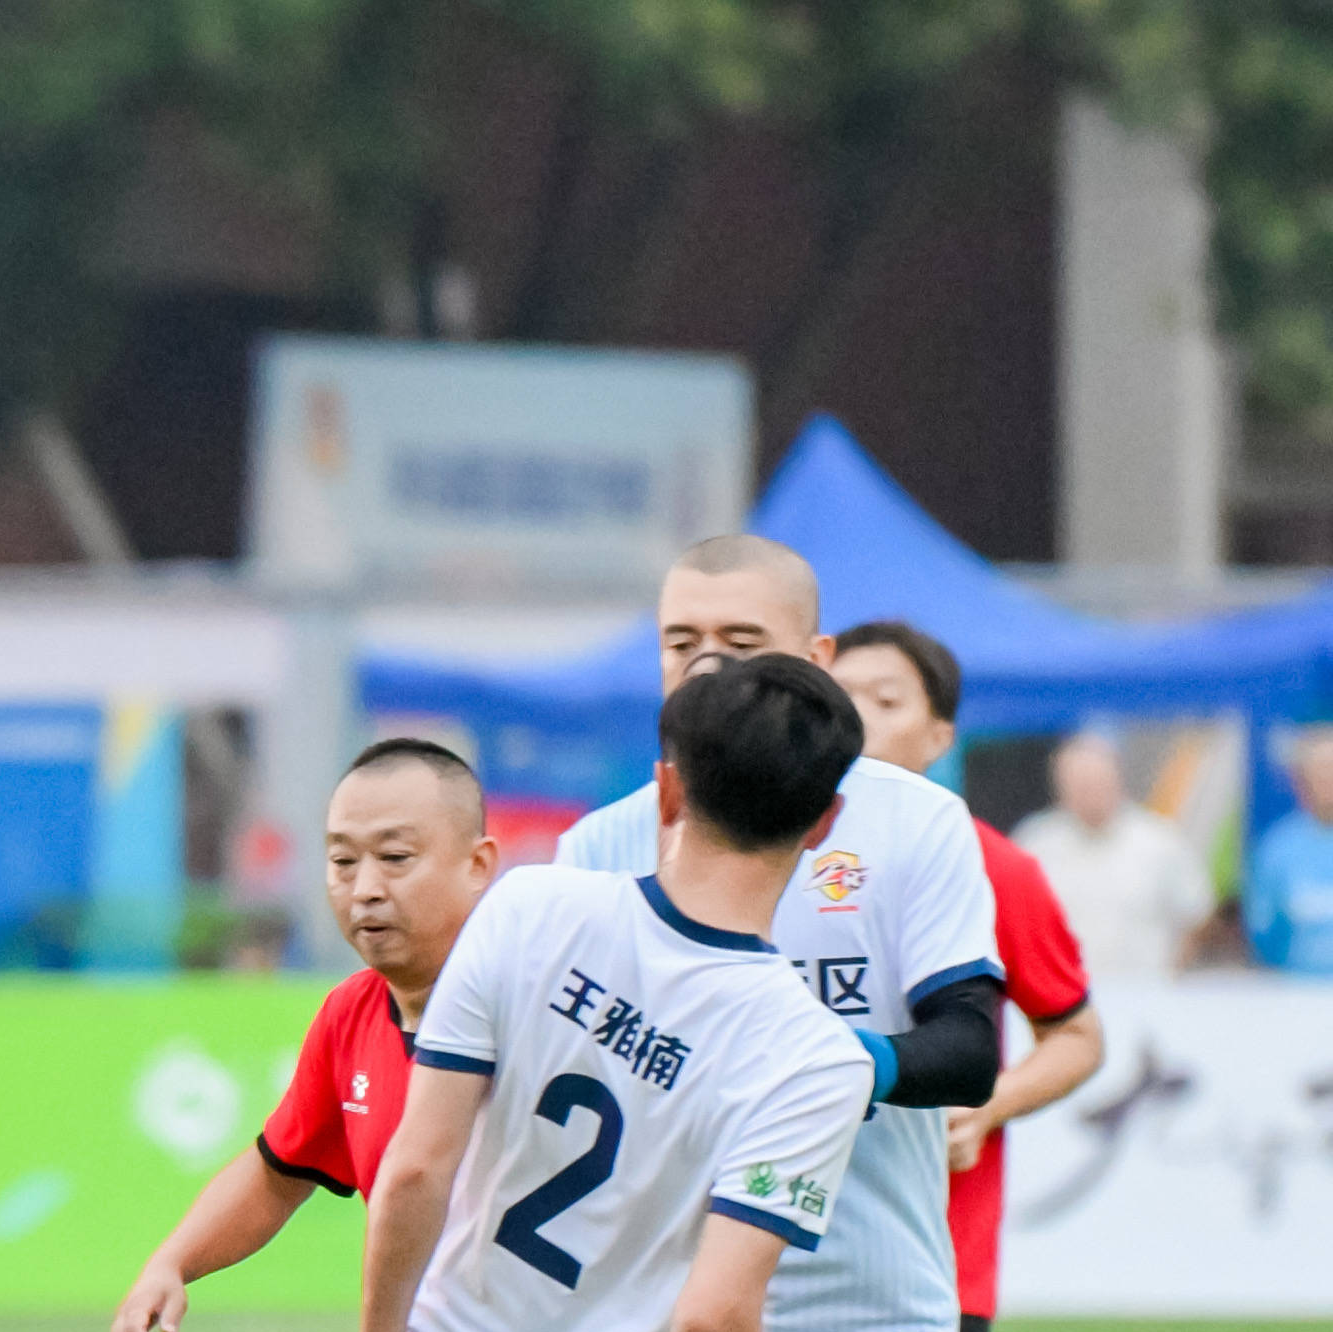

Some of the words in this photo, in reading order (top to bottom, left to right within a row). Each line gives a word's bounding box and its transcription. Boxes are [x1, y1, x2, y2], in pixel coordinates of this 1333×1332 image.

[549, 968, 692, 1091] 王雅楠
[495, 1073, 623, 1290] 2
